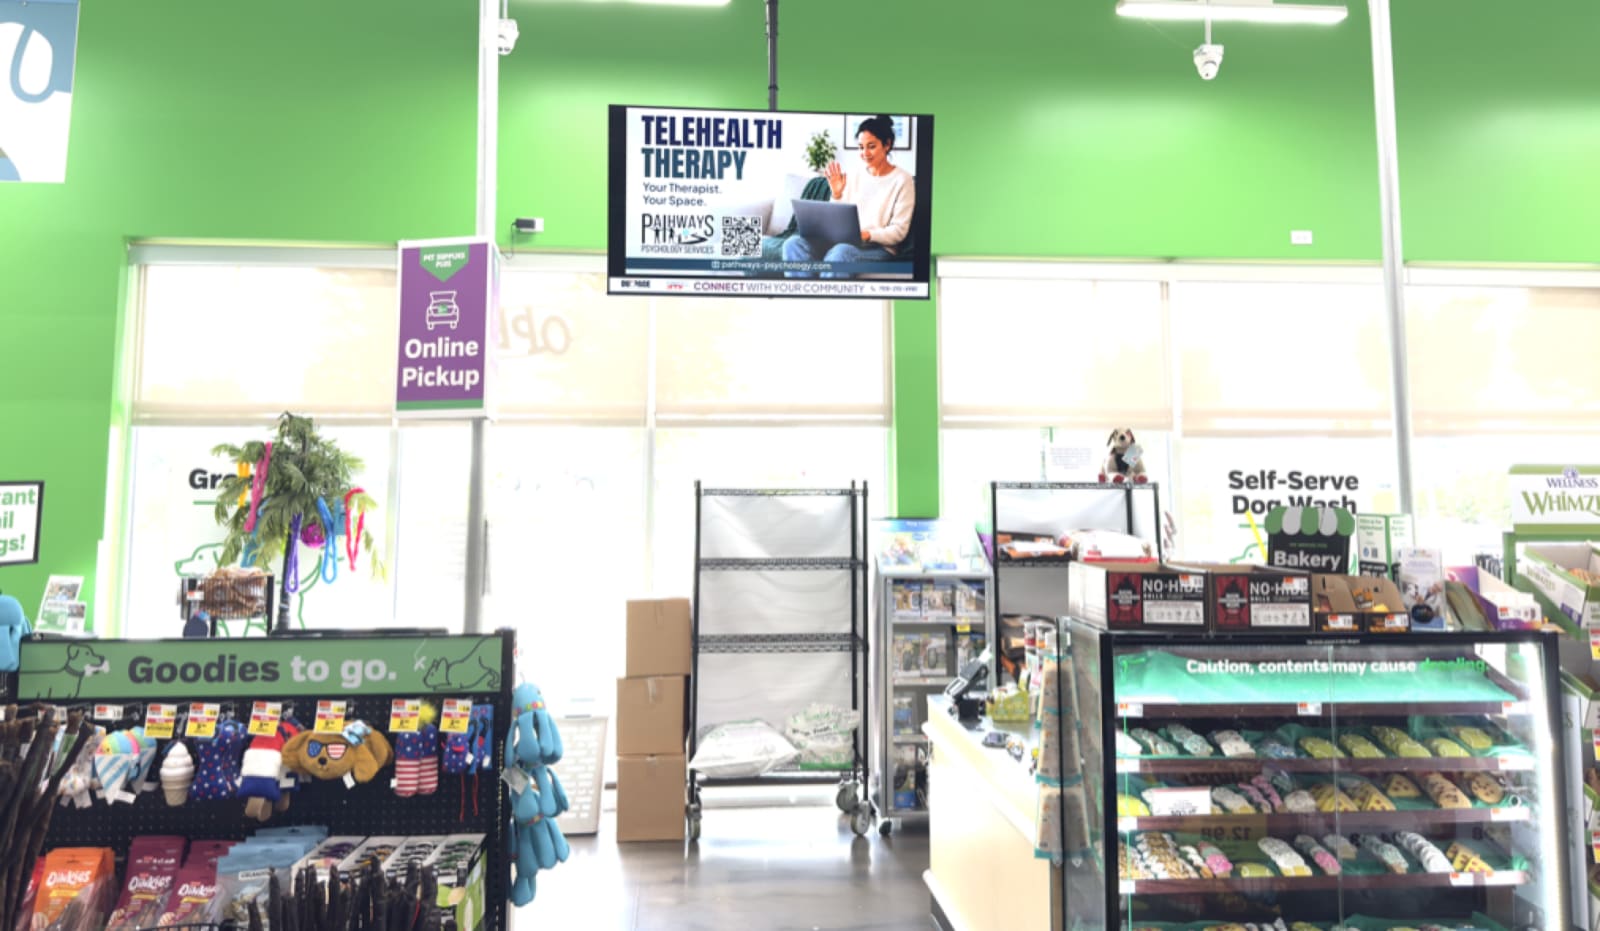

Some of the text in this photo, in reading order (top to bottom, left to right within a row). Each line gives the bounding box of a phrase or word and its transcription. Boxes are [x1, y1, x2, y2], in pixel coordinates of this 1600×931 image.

[641, 114, 783, 149] TELEHEALTH
[641, 148, 747, 180] THERAPY
[643, 182, 723, 195] Your Therapist.
[643, 195, 708, 207] Your Space.
[641, 244, 715, 254] PSYCHOLOGY SERVICES
[720, 260, 833, 272] pathways-psychology.com
[693, 281, 745, 292] CONNECT
[746, 283, 772, 292] WITH
[774, 283, 803, 292] YOUR
[803, 283, 866, 294] COMMUNITY
[404, 337, 479, 359] Online
[401, 365, 480, 391] Pickup
[1228, 469, 1359, 490] Self-Serve
[1546, 477, 1599, 488] WELLNESS
[0, 487, 37, 506] ant
[0, 510, 15, 529] il
[1273, 550, 1342, 571] Bakery
[127, 653, 398, 690] Goodies to go.
[1186, 658, 1255, 675] Caution,
[1258, 659, 1329, 673] contents
[1332, 660, 1369, 676] may
[1370, 661, 1417, 672] cause
